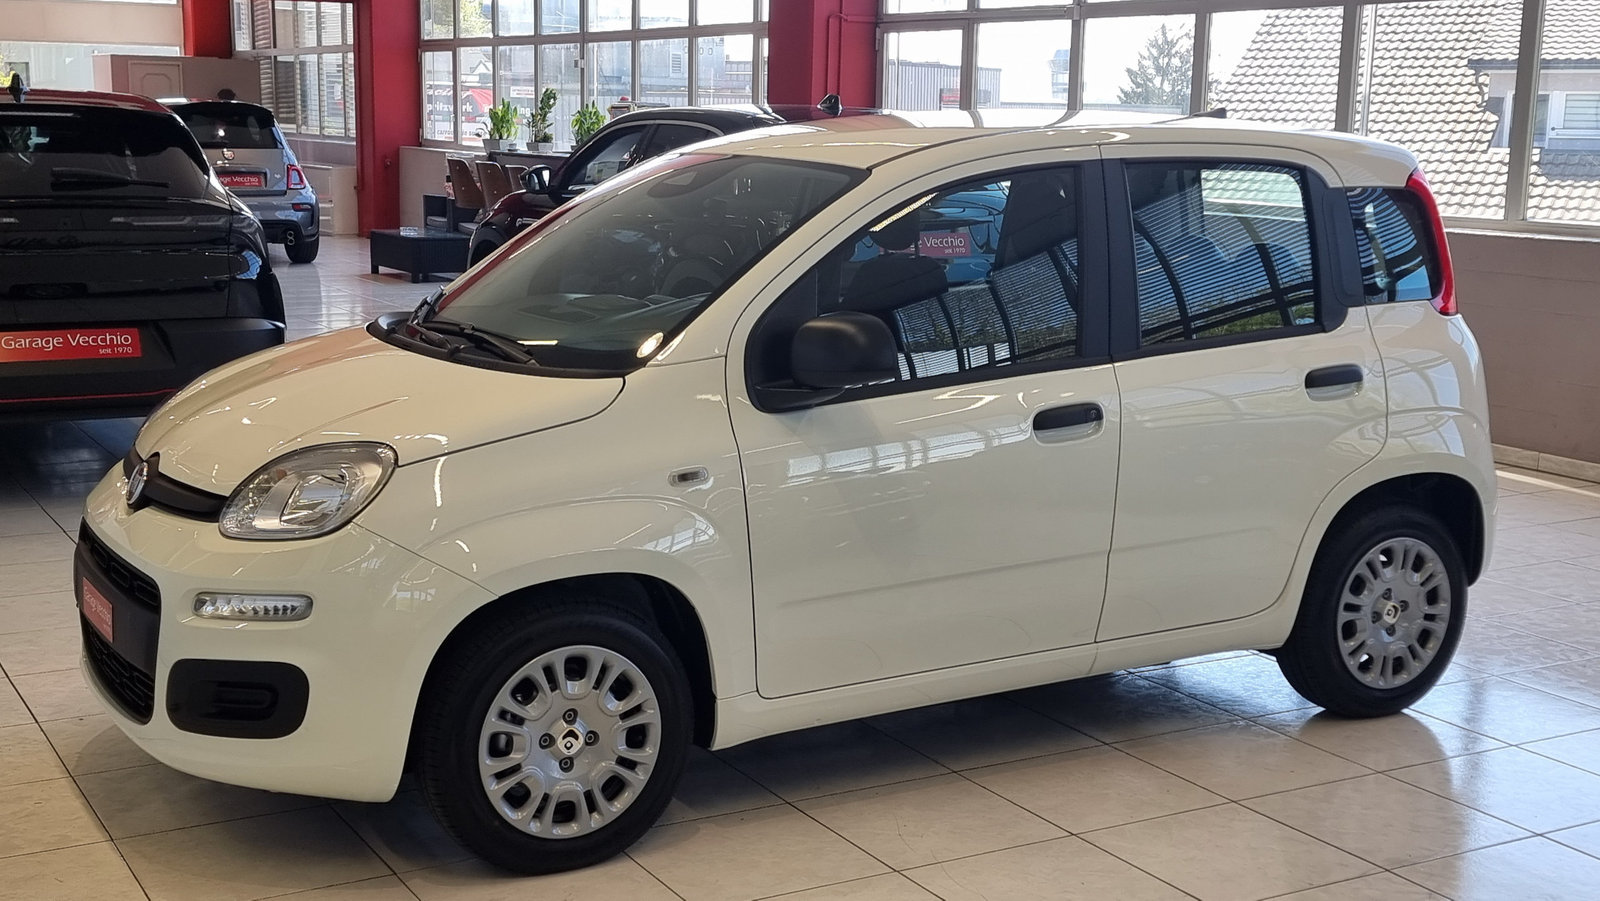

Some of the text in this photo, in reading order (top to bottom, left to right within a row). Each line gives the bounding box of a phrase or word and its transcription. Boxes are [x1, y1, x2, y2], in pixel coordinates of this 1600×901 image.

[924, 236, 965, 247] Vecchio
[1, 332, 132, 351] Garage Vecchio
[113, 346, 133, 354] 1970
